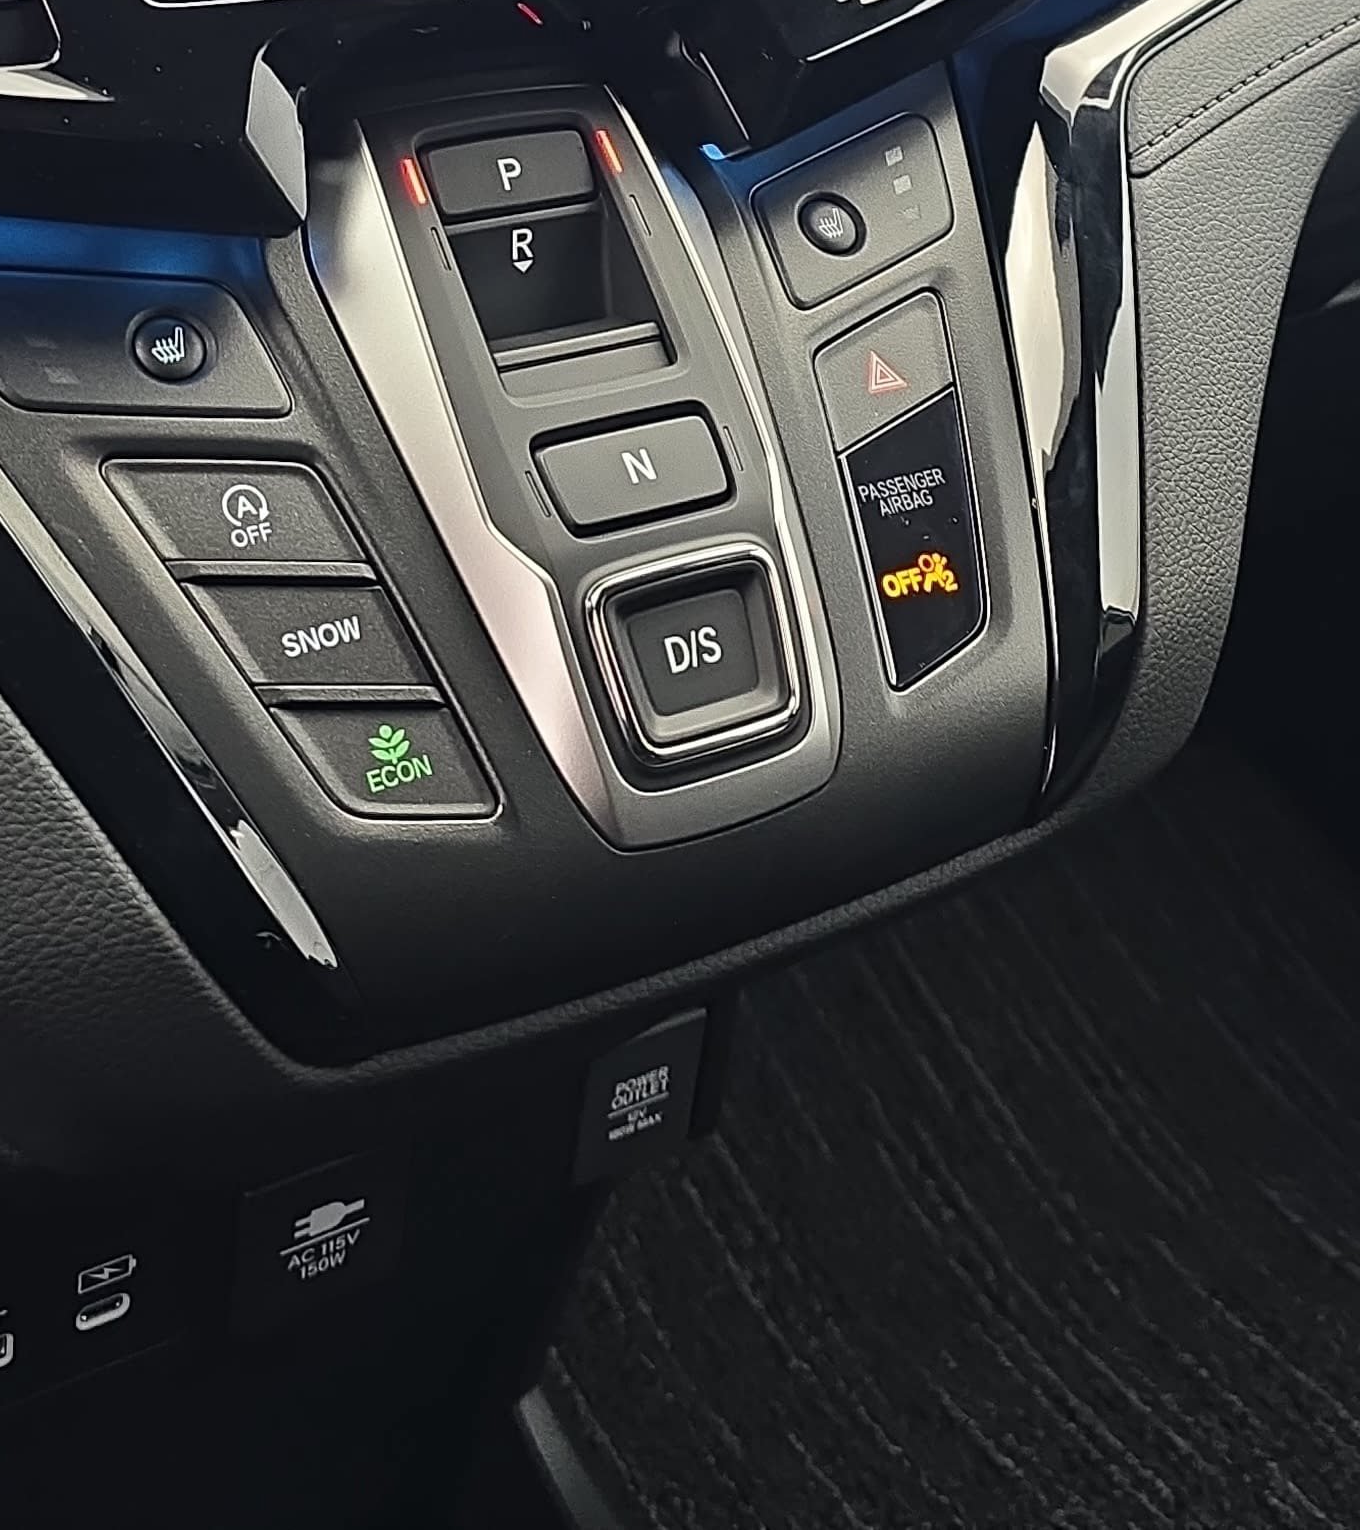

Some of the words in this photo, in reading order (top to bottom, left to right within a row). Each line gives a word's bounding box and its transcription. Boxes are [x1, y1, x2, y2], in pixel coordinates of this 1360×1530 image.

[497, 155, 523, 191] P
[511, 227, 535, 261] R
[621, 447, 658, 485] N
[857, 467, 946, 503] PASSENGER
[879, 489, 934, 517] AIRBAG
[230, 521, 273, 548] OFF
[882, 566, 924, 598] OFF
[281, 615, 362, 658] SNOW
[664, 625, 723, 675] D/S
[366, 754, 433, 794] ECON
[611, 1078, 667, 1110] OUTLET
[615, 1064, 670, 1097] POWER
[287, 1247, 316, 1270] AC
[321, 1228, 360, 1256] 115V
[300, 1248, 346, 1280] 150W
